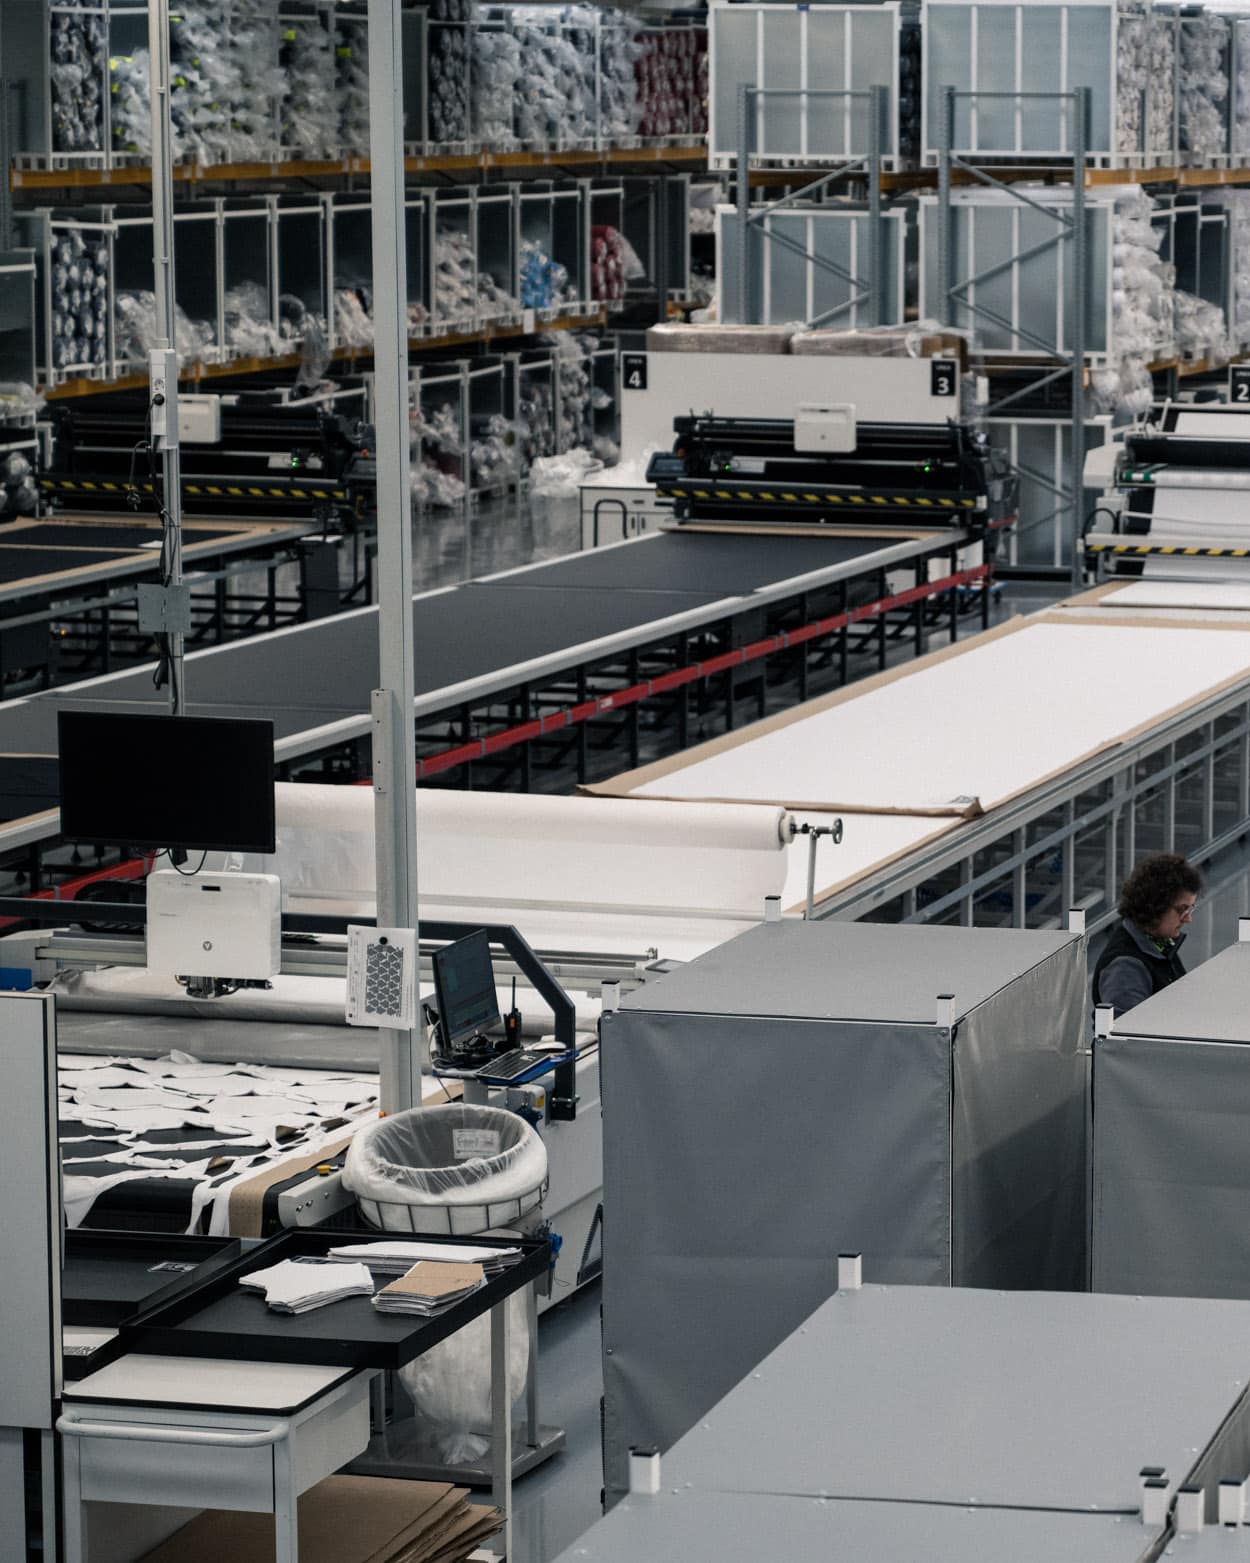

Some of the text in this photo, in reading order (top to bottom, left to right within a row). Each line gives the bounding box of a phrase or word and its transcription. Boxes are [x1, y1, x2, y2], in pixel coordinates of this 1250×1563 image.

[629, 370, 641, 387] 4
[938, 377, 949, 394] 3
[1237, 384, 1249, 401] 2
